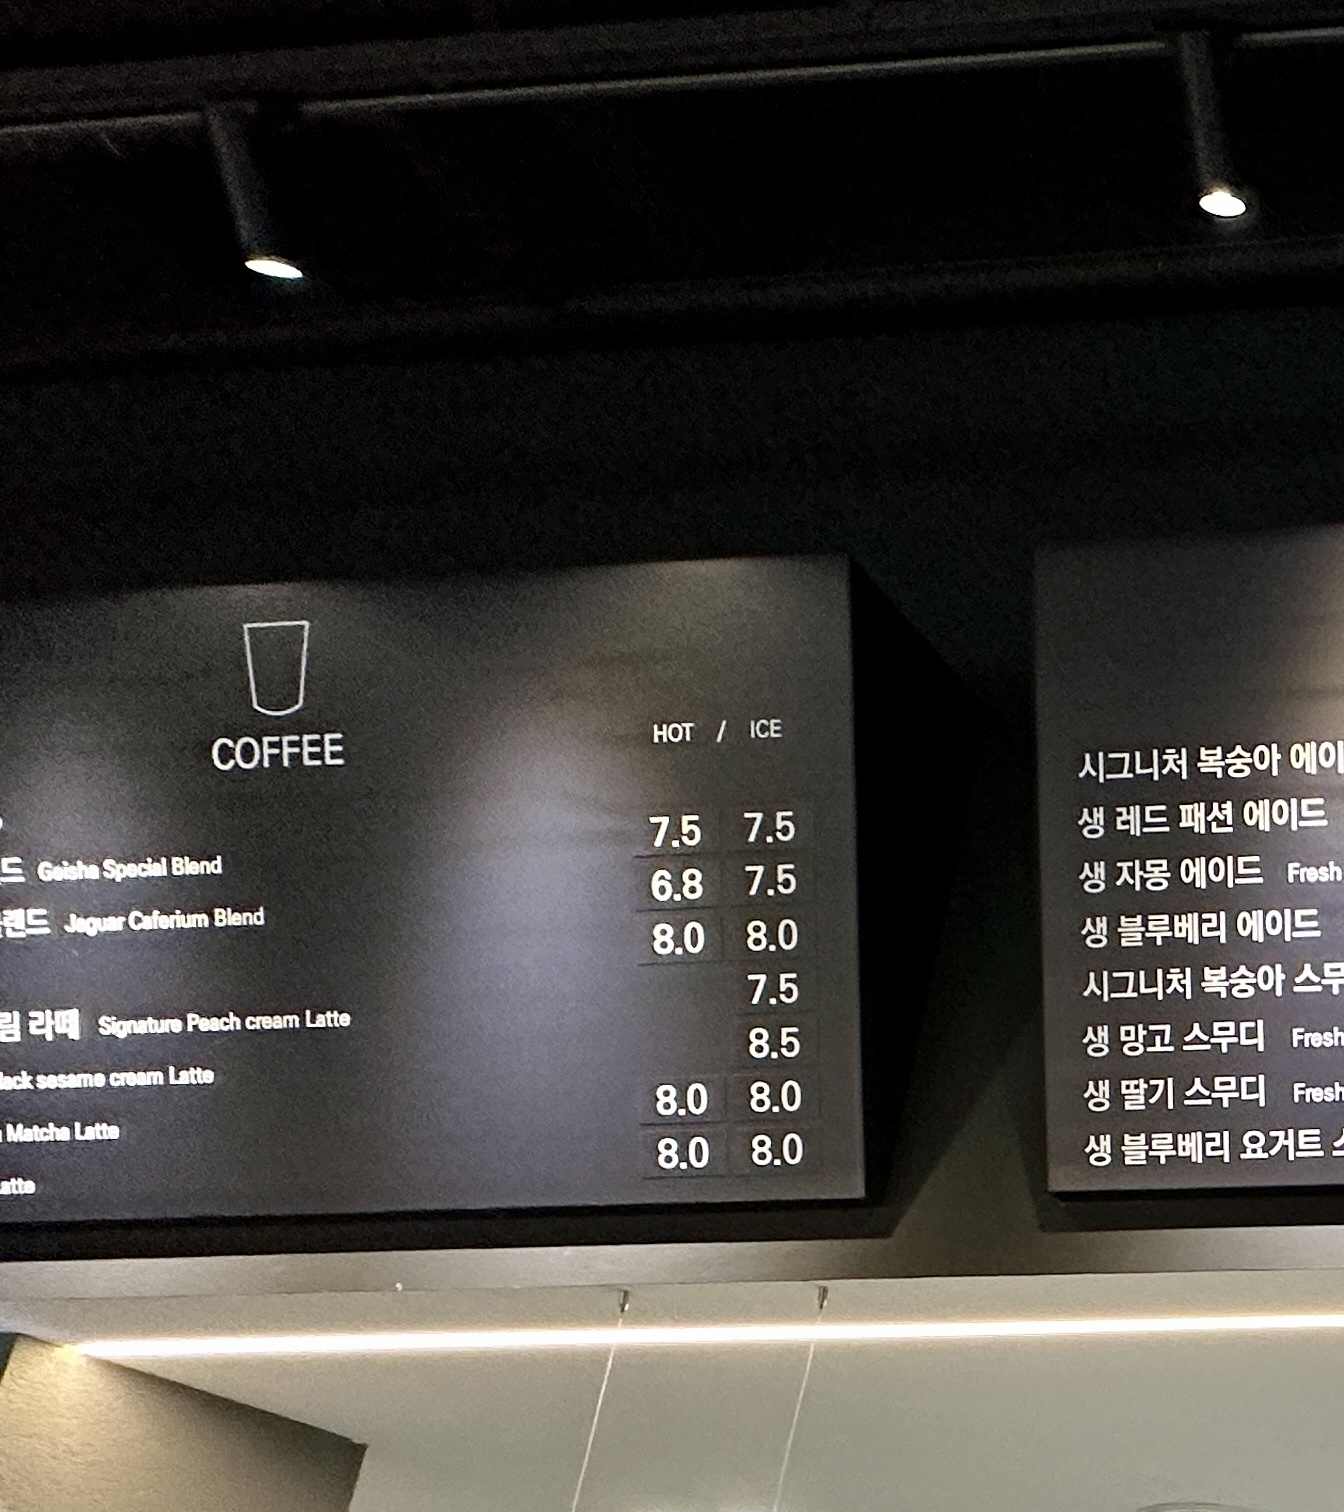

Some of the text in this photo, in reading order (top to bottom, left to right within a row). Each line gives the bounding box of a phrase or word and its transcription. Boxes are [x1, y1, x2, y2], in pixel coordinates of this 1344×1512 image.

[654, 719, 781, 742] HOT ICE
[212, 733, 344, 770] COFFEE
[1079, 748, 1187, 783] 시그니처
[1197, 743, 1281, 778] 복숭아
[650, 811, 794, 847] 7.5 7.5
[1078, 807, 1104, 838] 생
[1116, 805, 1170, 836] 레드
[1179, 801, 1233, 834] 패션
[1244, 798, 1327, 831] 에이드
[103, 857, 167, 882] Special
[172, 856, 222, 875] Blend
[652, 864, 796, 901] 6.8 7.5
[1079, 861, 1105, 893] 생
[1116, 859, 1171, 891] 자몽
[1181, 856, 1263, 889] 에이드
[1288, 861, 1342, 883] Fresh
[128, 910, 209, 930] Caferium
[214, 907, 264, 927] Blend
[1081, 916, 1107, 948] 생
[1118, 911, 1226, 946] 블루베리
[1237, 909, 1321, 942] 에이드
[653, 919, 797, 955] 8.0 8.0
[748, 973, 798, 1004] 7.5
[1084, 967, 1191, 1002] 시그니처
[1201, 964, 1285, 998] 복숭아
[29, 1008, 350, 1041] 라떼 Signature Peach cream Latte
[1083, 1025, 1109, 1057] 생
[1120, 1024, 1174, 1056] 망고
[1183, 1020, 1264, 1053] 스무디
[749, 1027, 799, 1059] 8.5
[109, 1071, 164, 1086] cream
[169, 1066, 214, 1084] Latte
[1084, 1080, 1110, 1111] 생
[1121, 1078, 1173, 1110] 딸기
[1184, 1075, 1265, 1107] 스무디
[656, 1080, 801, 1116] 8.0 8.0
[6, 1122, 119, 1142] Matcha Latte
[1085, 1134, 1111, 1166] 생
[1121, 1131, 1229, 1164] 블루베리
[1240, 1129, 1324, 1160] 요거트
